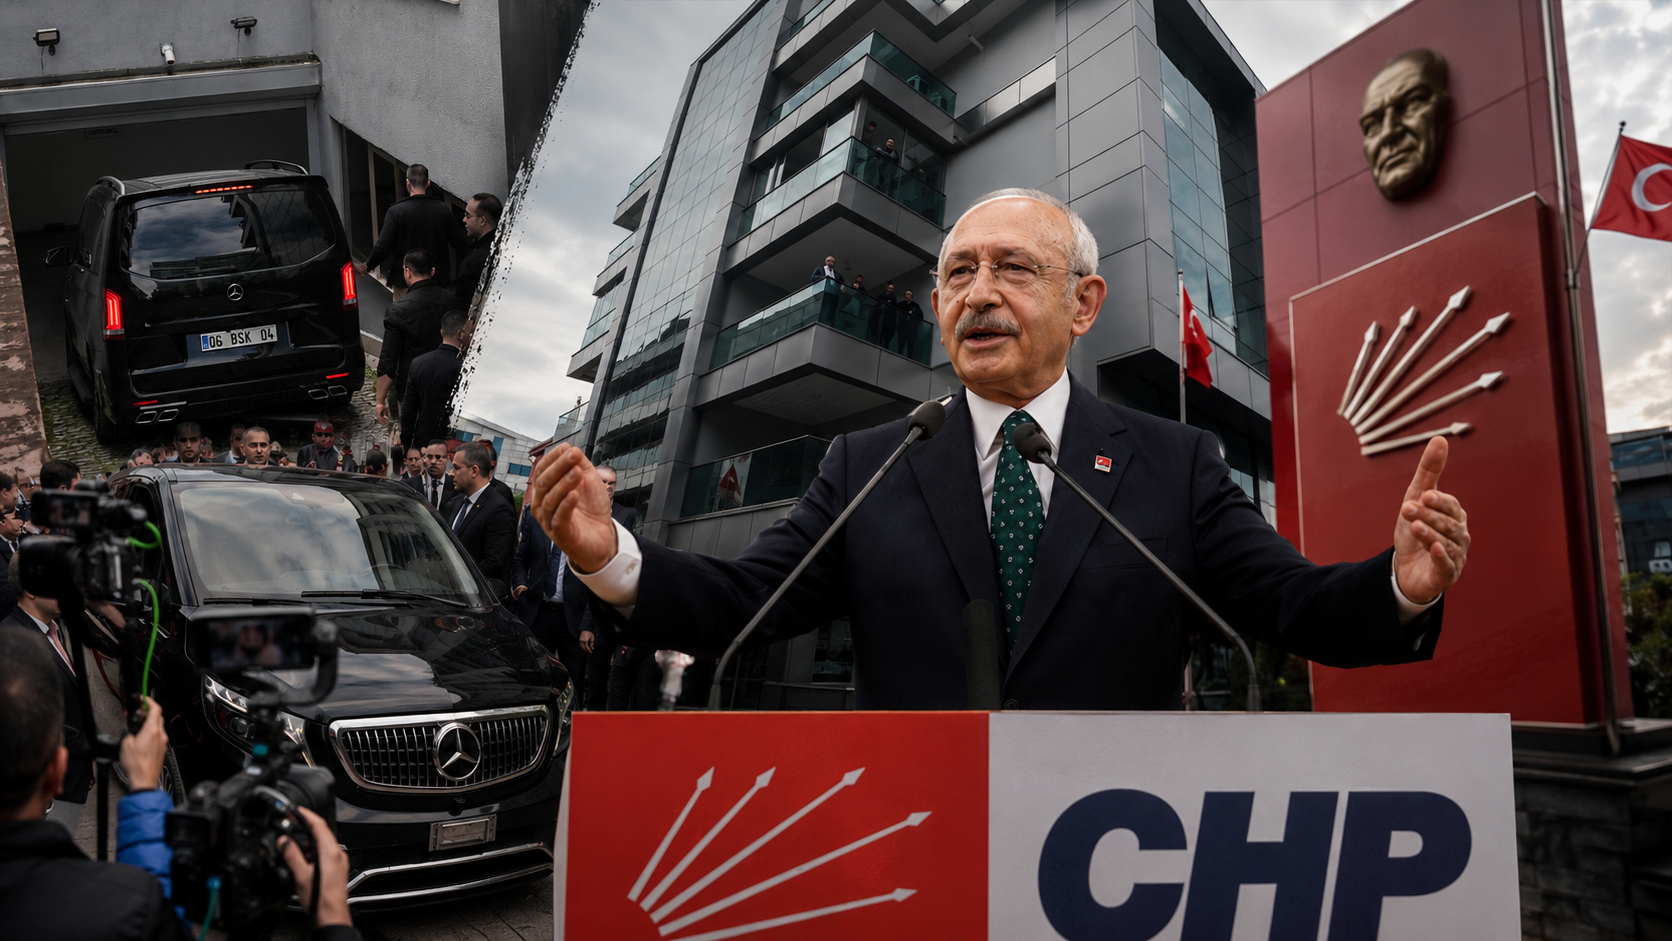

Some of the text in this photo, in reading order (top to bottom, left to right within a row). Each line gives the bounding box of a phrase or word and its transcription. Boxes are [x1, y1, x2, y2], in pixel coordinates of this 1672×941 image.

[209, 335, 223, 348] 06
[230, 331, 252, 345] BSK
[260, 328, 274, 341] 04
[1038, 788, 1472, 941] CHP
